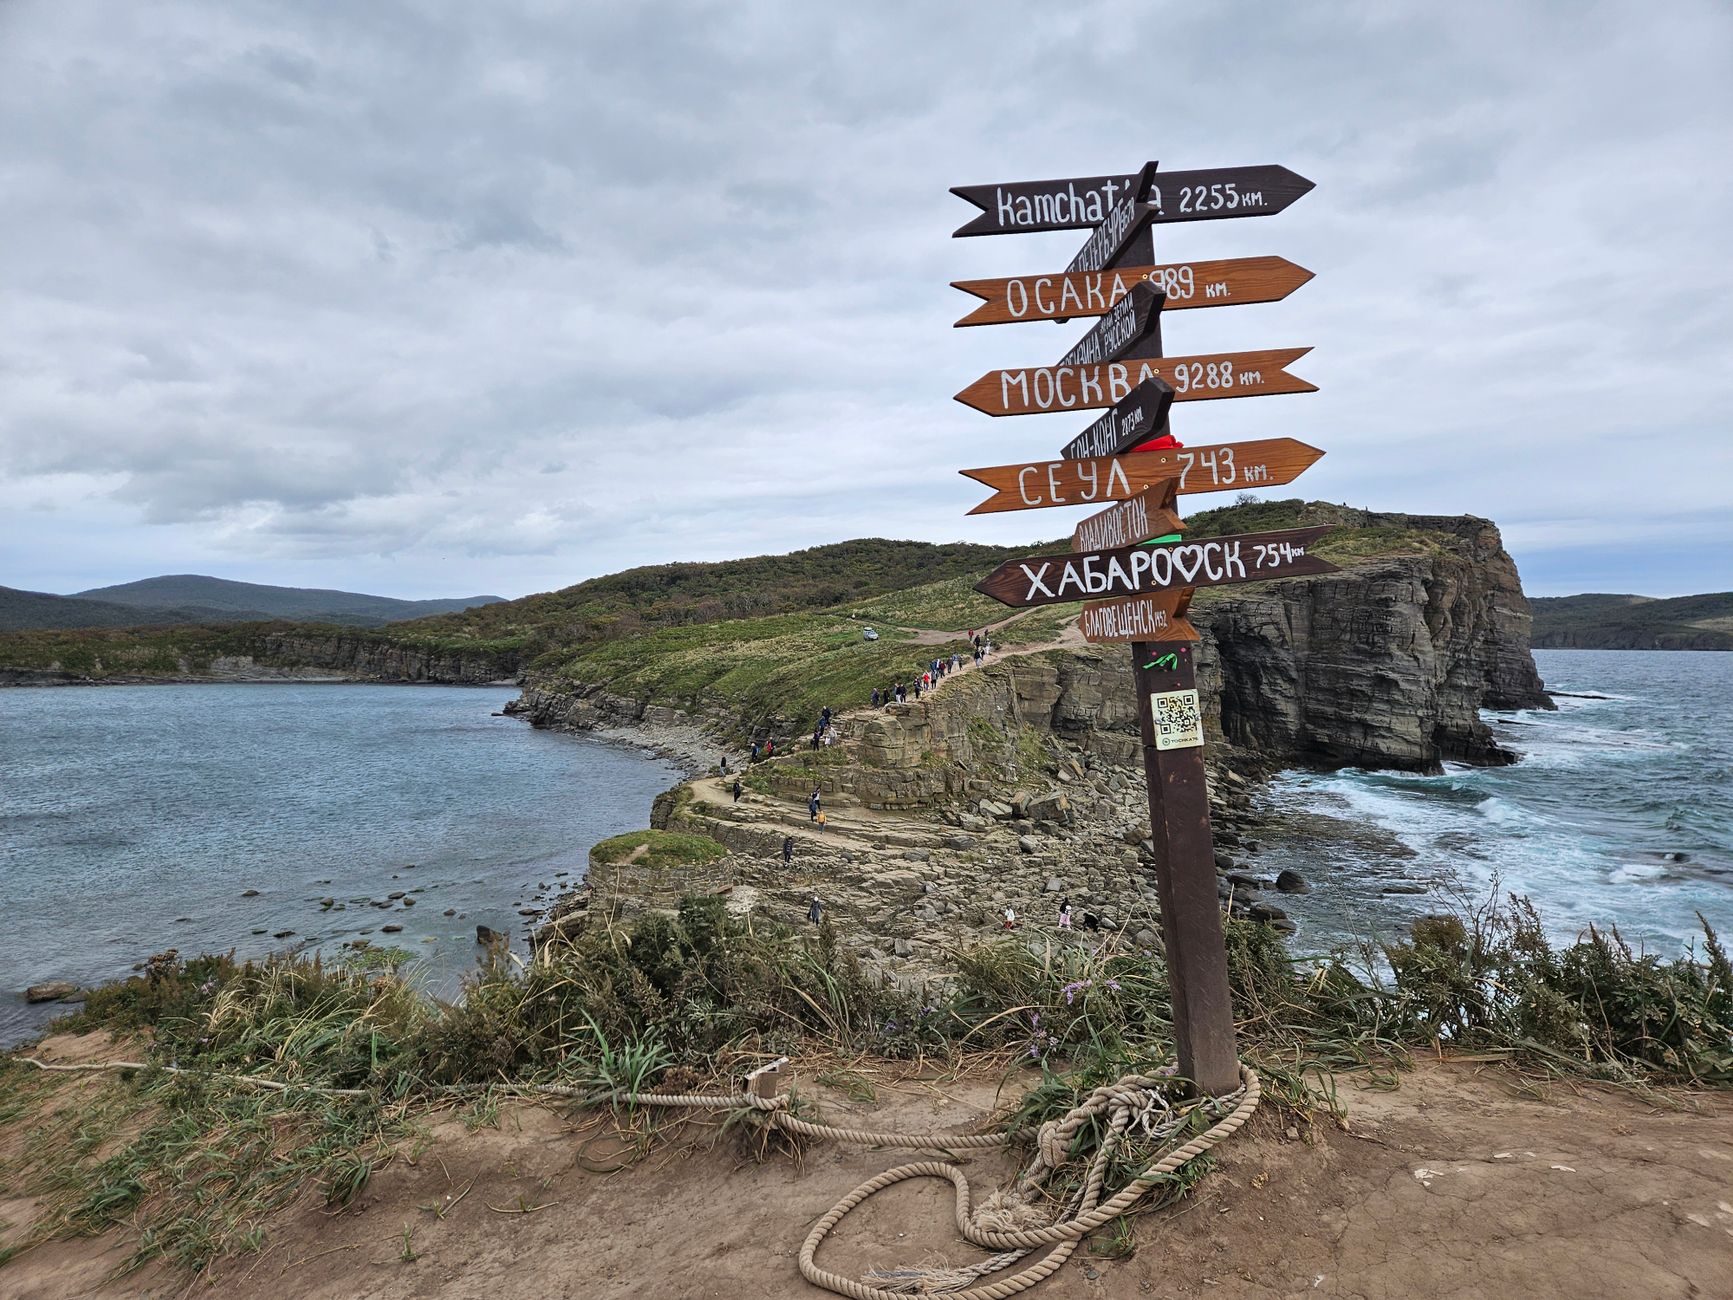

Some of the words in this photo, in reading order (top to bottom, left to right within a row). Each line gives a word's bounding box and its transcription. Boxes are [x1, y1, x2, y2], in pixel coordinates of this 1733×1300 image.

[997, 179, 1164, 226] kamchata
[1180, 183, 1240, 213] 2255
[1007, 273, 1127, 317] ОСАКА
[1149, 266, 1195, 300] 989
[1175, 361, 1234, 393] 9288
[1018, 458, 1131, 506] СЕУЛ
[1177, 447, 1237, 489] 743
[1079, 495, 1149, 553] ВЛАДИВОСТОК
[1084, 599, 1156, 639] БЛАГОВЕЩЕНСК
